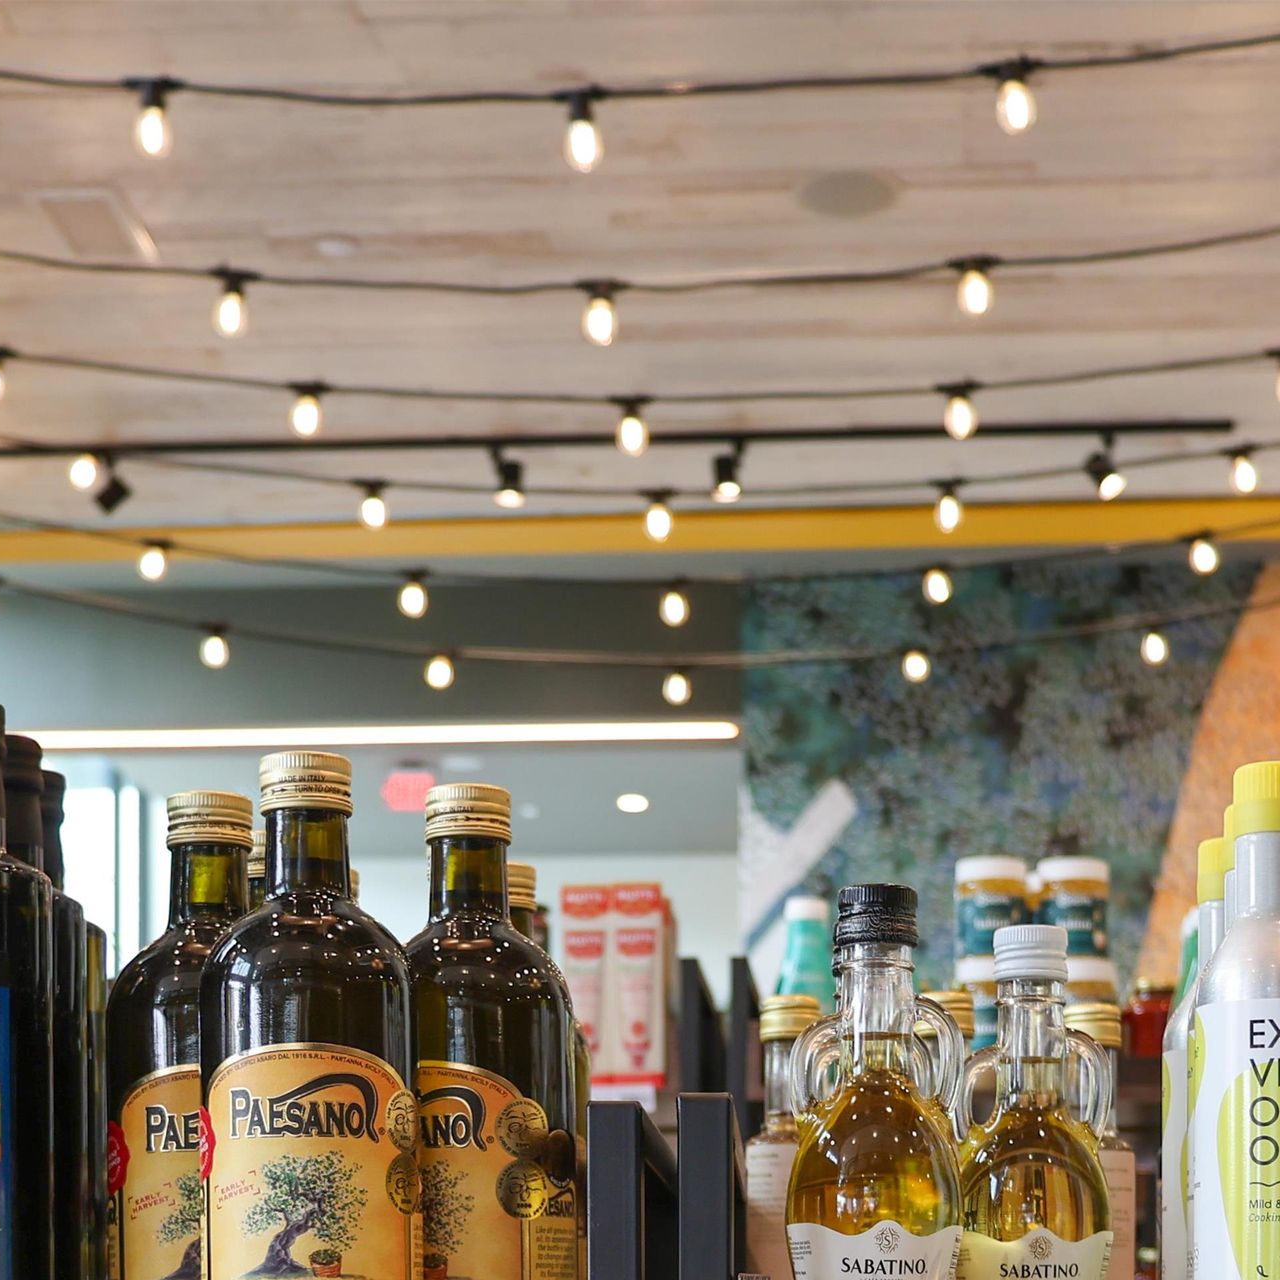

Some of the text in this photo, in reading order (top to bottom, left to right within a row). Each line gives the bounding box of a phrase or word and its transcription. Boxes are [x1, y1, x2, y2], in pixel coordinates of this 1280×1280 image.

[229, 1080, 379, 1141] PAESANO
[841, 1257, 926, 1275] SABATINO
[1000, 1263, 1077, 1278] SABATINO
